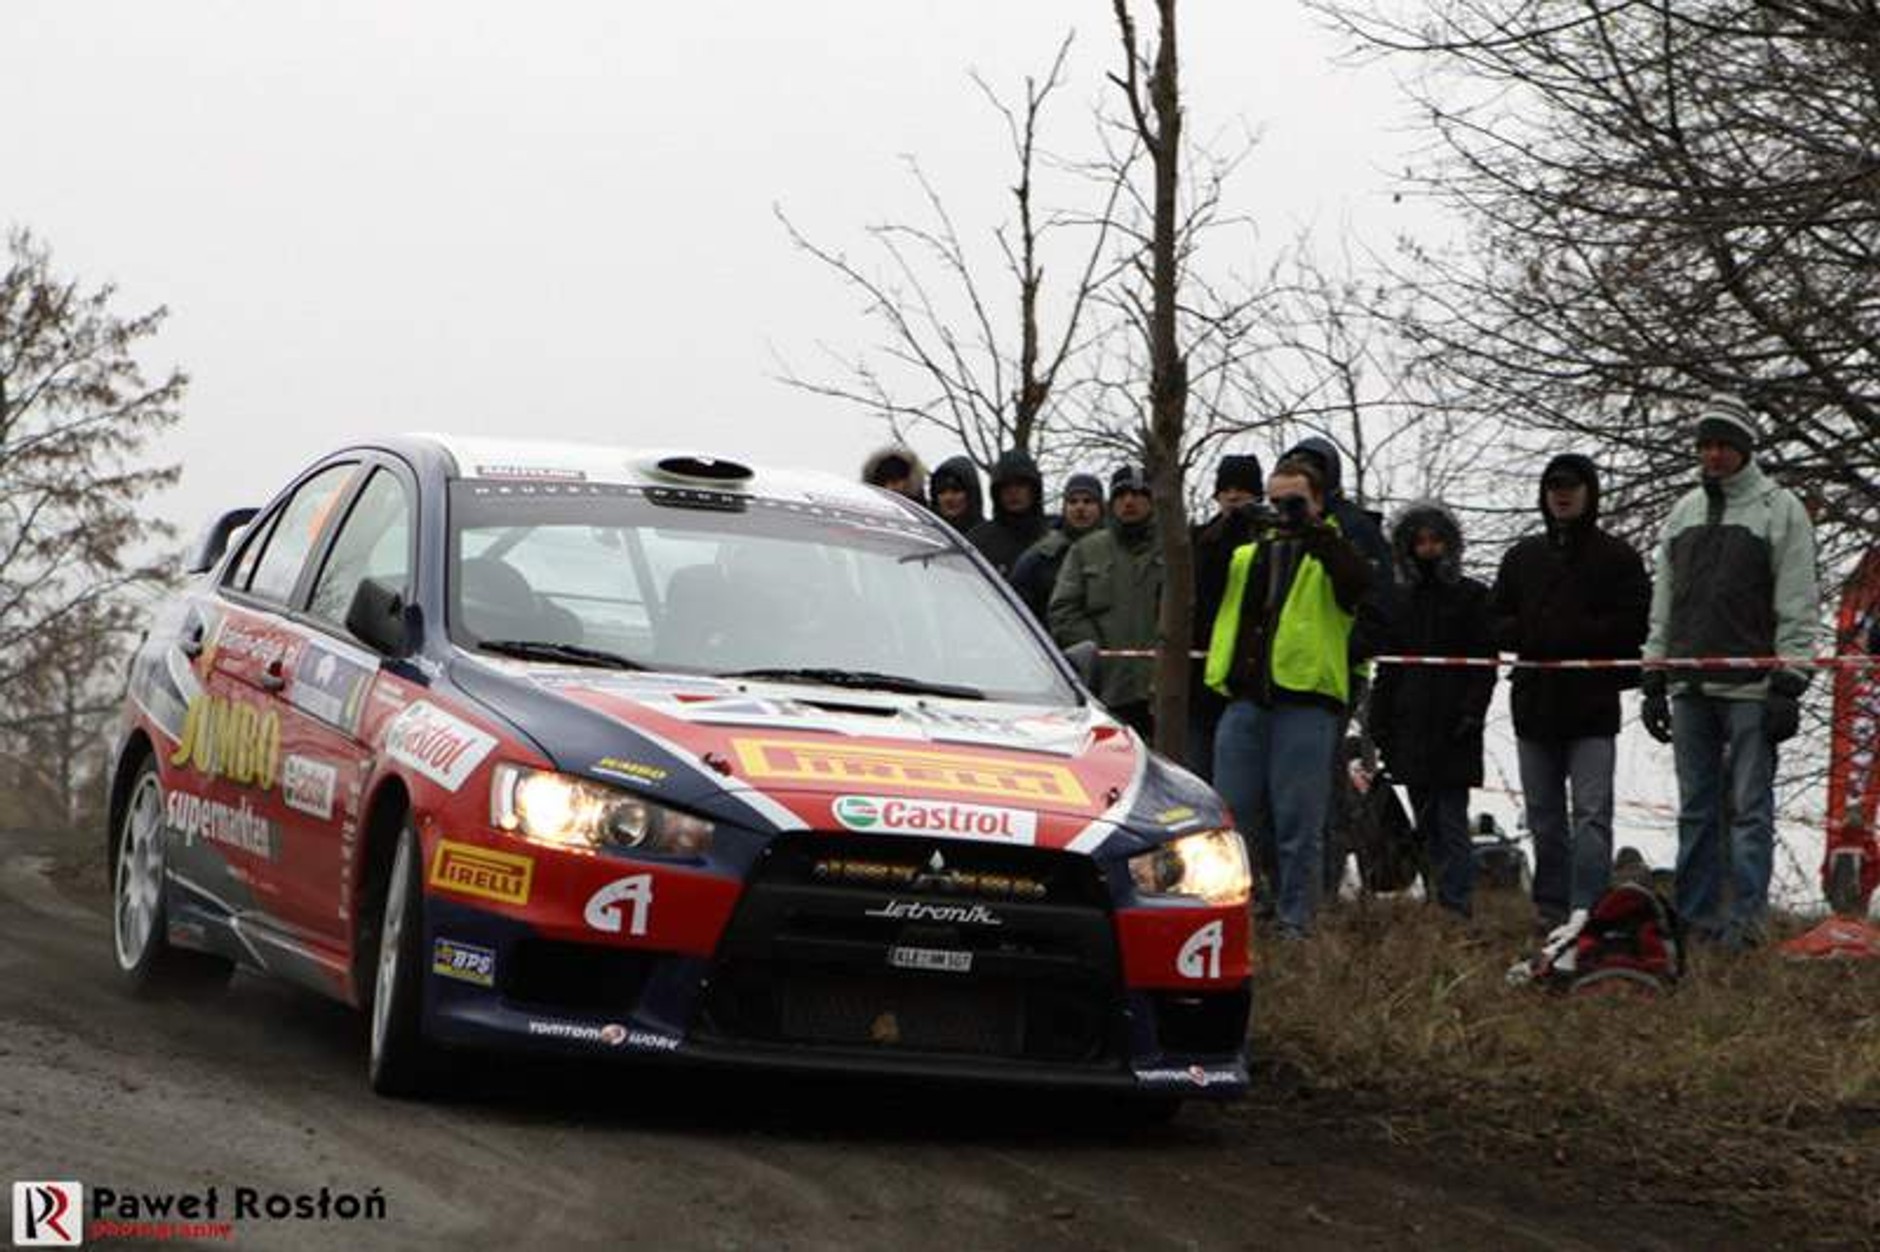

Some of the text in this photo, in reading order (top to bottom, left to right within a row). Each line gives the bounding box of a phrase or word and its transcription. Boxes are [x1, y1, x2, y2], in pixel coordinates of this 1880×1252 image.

[169, 693, 282, 791] JUMBO
[883, 799, 1013, 838] Castrol
[438, 850, 528, 899] PIRELLI
[452, 950, 492, 976] BPS
